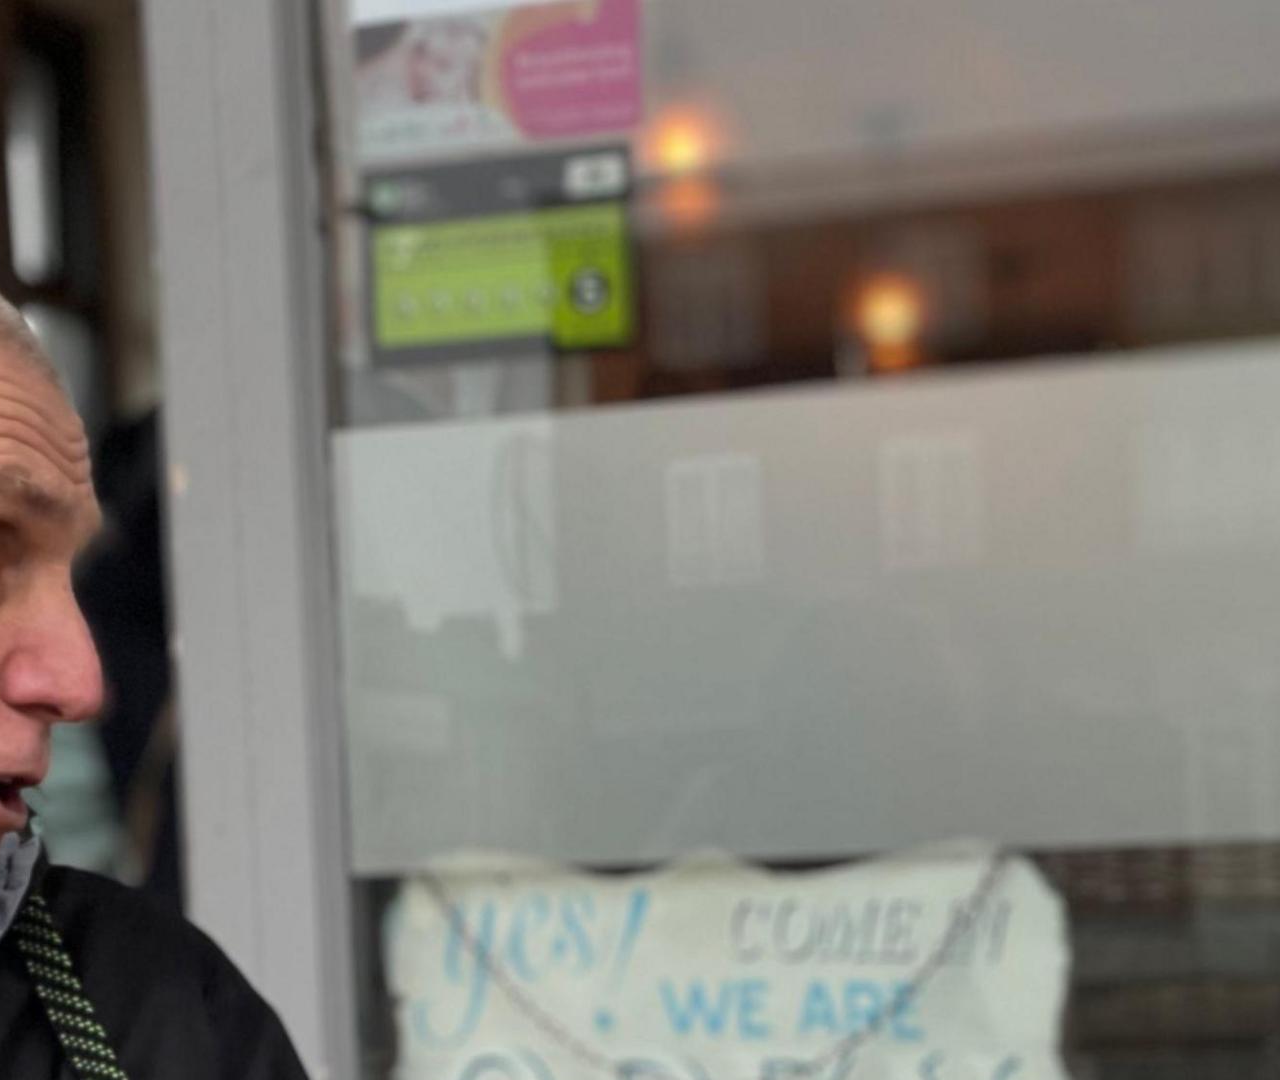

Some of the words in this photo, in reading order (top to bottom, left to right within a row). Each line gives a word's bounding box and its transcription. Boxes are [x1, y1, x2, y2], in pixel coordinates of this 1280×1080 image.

[730, 898, 921, 966] COME
[658, 978, 771, 1042] WE
[795, 976, 926, 1042] ARE
